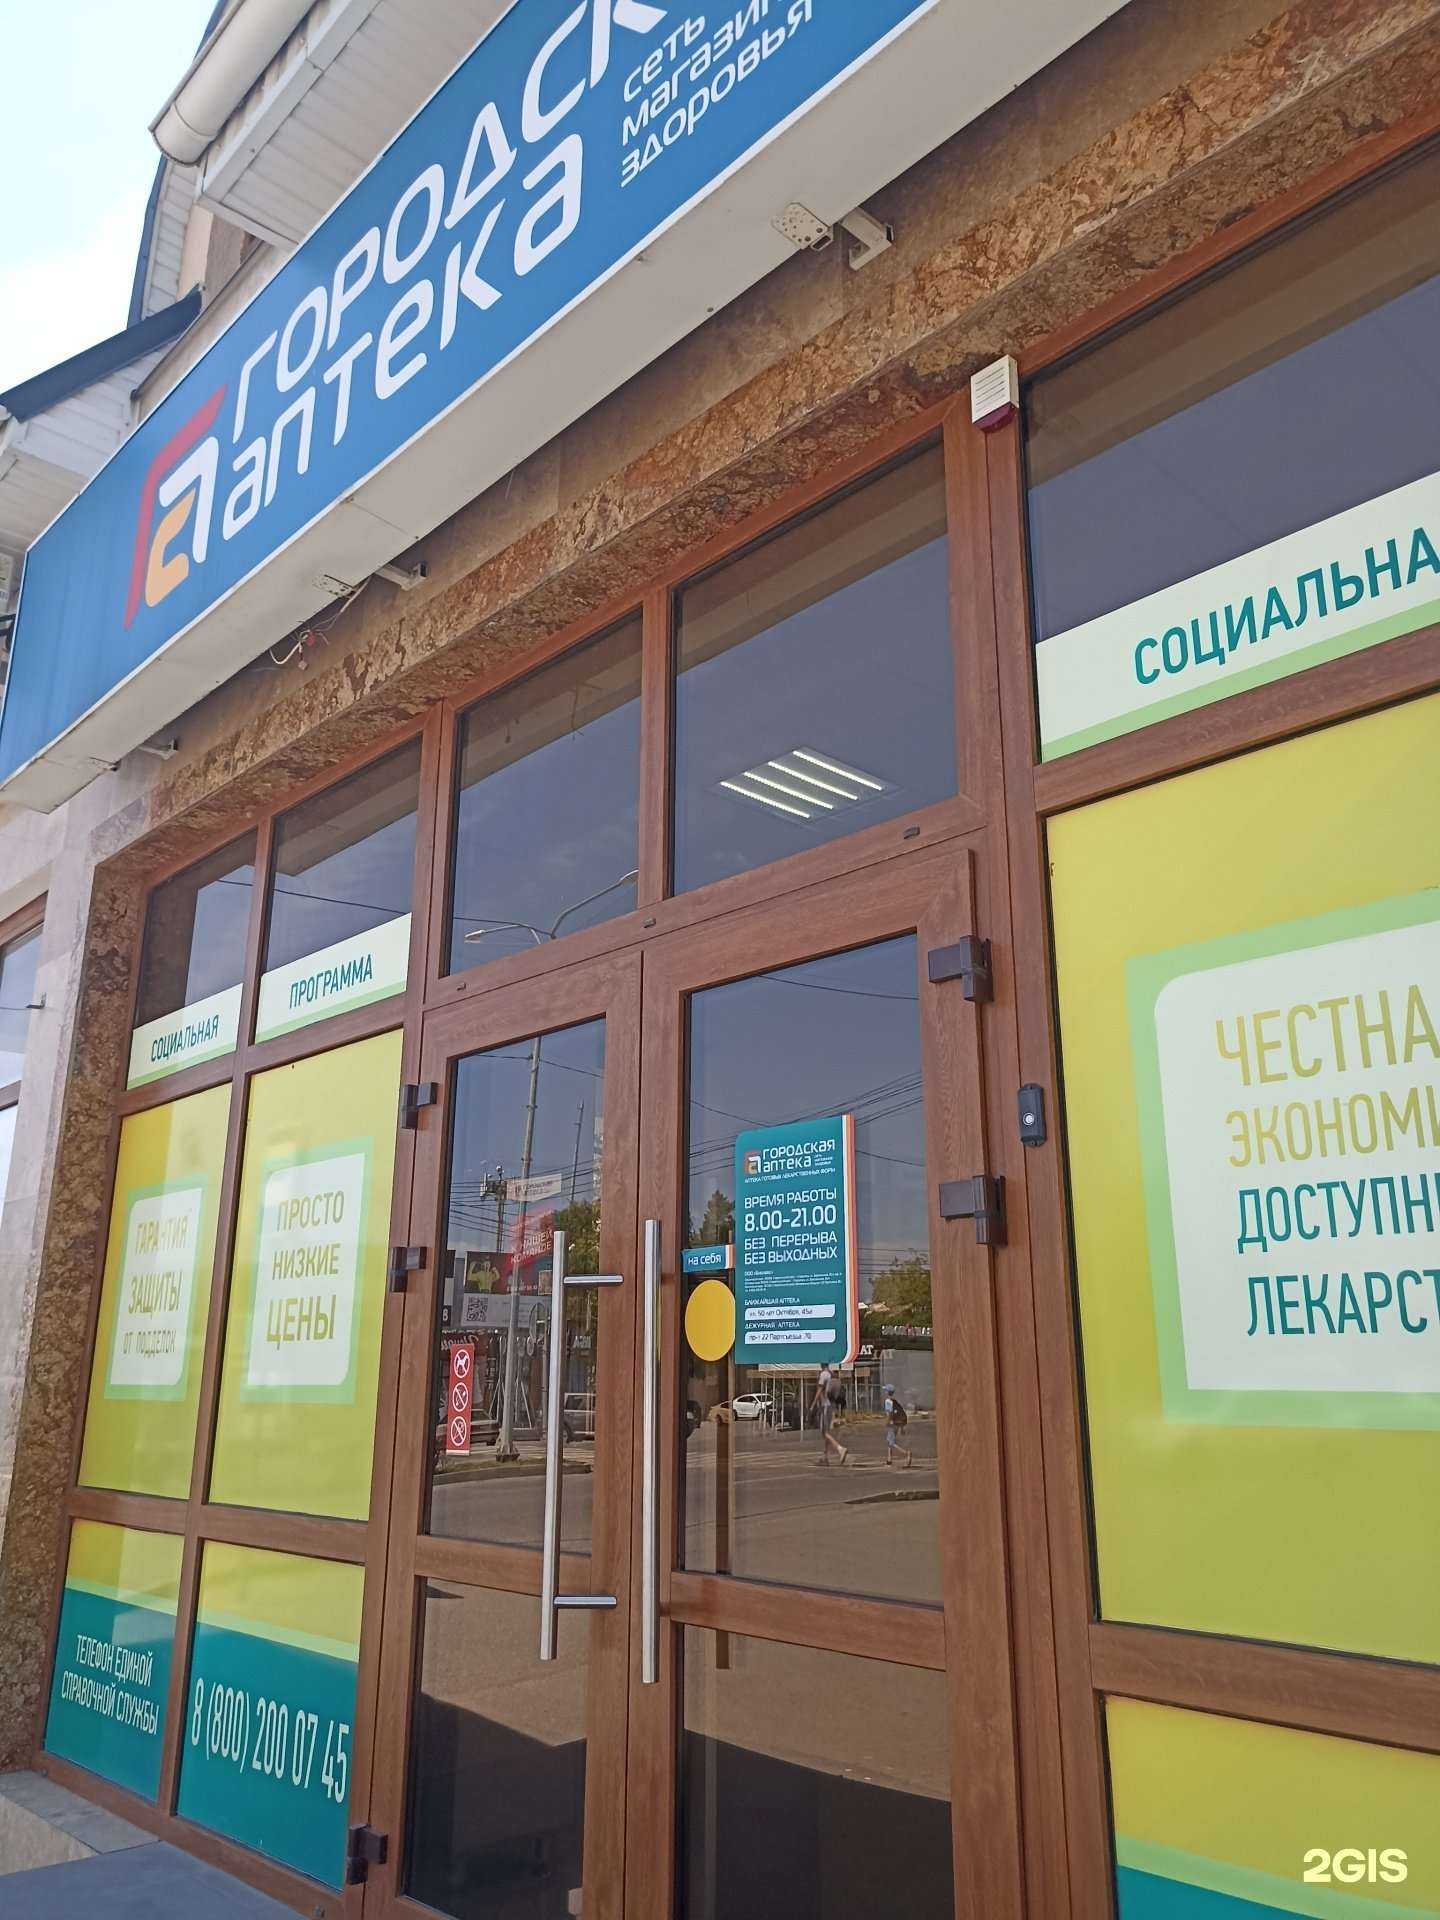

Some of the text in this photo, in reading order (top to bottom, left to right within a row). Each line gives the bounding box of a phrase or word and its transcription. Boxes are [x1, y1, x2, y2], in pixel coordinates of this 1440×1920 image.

[222, 134, 583, 540] аптека
[1134, 527, 1440, 684] СОЦИАЛЬНА
[289, 954, 373, 1009] ПРОГРАММА
[151, 1014, 219, 1062] СОЦИАЛЬНАЯ
[1215, 984, 1440, 1086] ЧЕСТНА
[276, 1190, 345, 1232] ПРОСТО
[745, 1188, 836, 1209] ВРЕМЯ РАБОТЫ
[745, 1204, 836, 1232] 8.00-21.00
[1238, 1173, 1440, 1254] ДОСТУПН
[135, 1216, 188, 1255] ГАРАНТИЯ
[688, 1253, 722, 1265] на себя
[745, 1231, 837, 1250] БЕЗ ПЕРЕРЫВА
[745, 1246, 837, 1265] БЕЗ ВЫХОДНЫХ
[272, 1242, 341, 1280] НИЗКИЕ
[129, 1270, 183, 1319] ЗАЩИТЫ
[123, 1329, 177, 1358] ОТ ПОДДЕЛОК
[266, 1294, 337, 1351] ЦЕНЫ
[76, 1634, 153, 1687] ТЕЛЕФОН ЕДИНОЙ
[61, 1670, 160, 1735] СПРАВОЧНОЙ СЛУЖБЫ
[191, 1677, 350, 1803] 8 (800) 200 07 45
